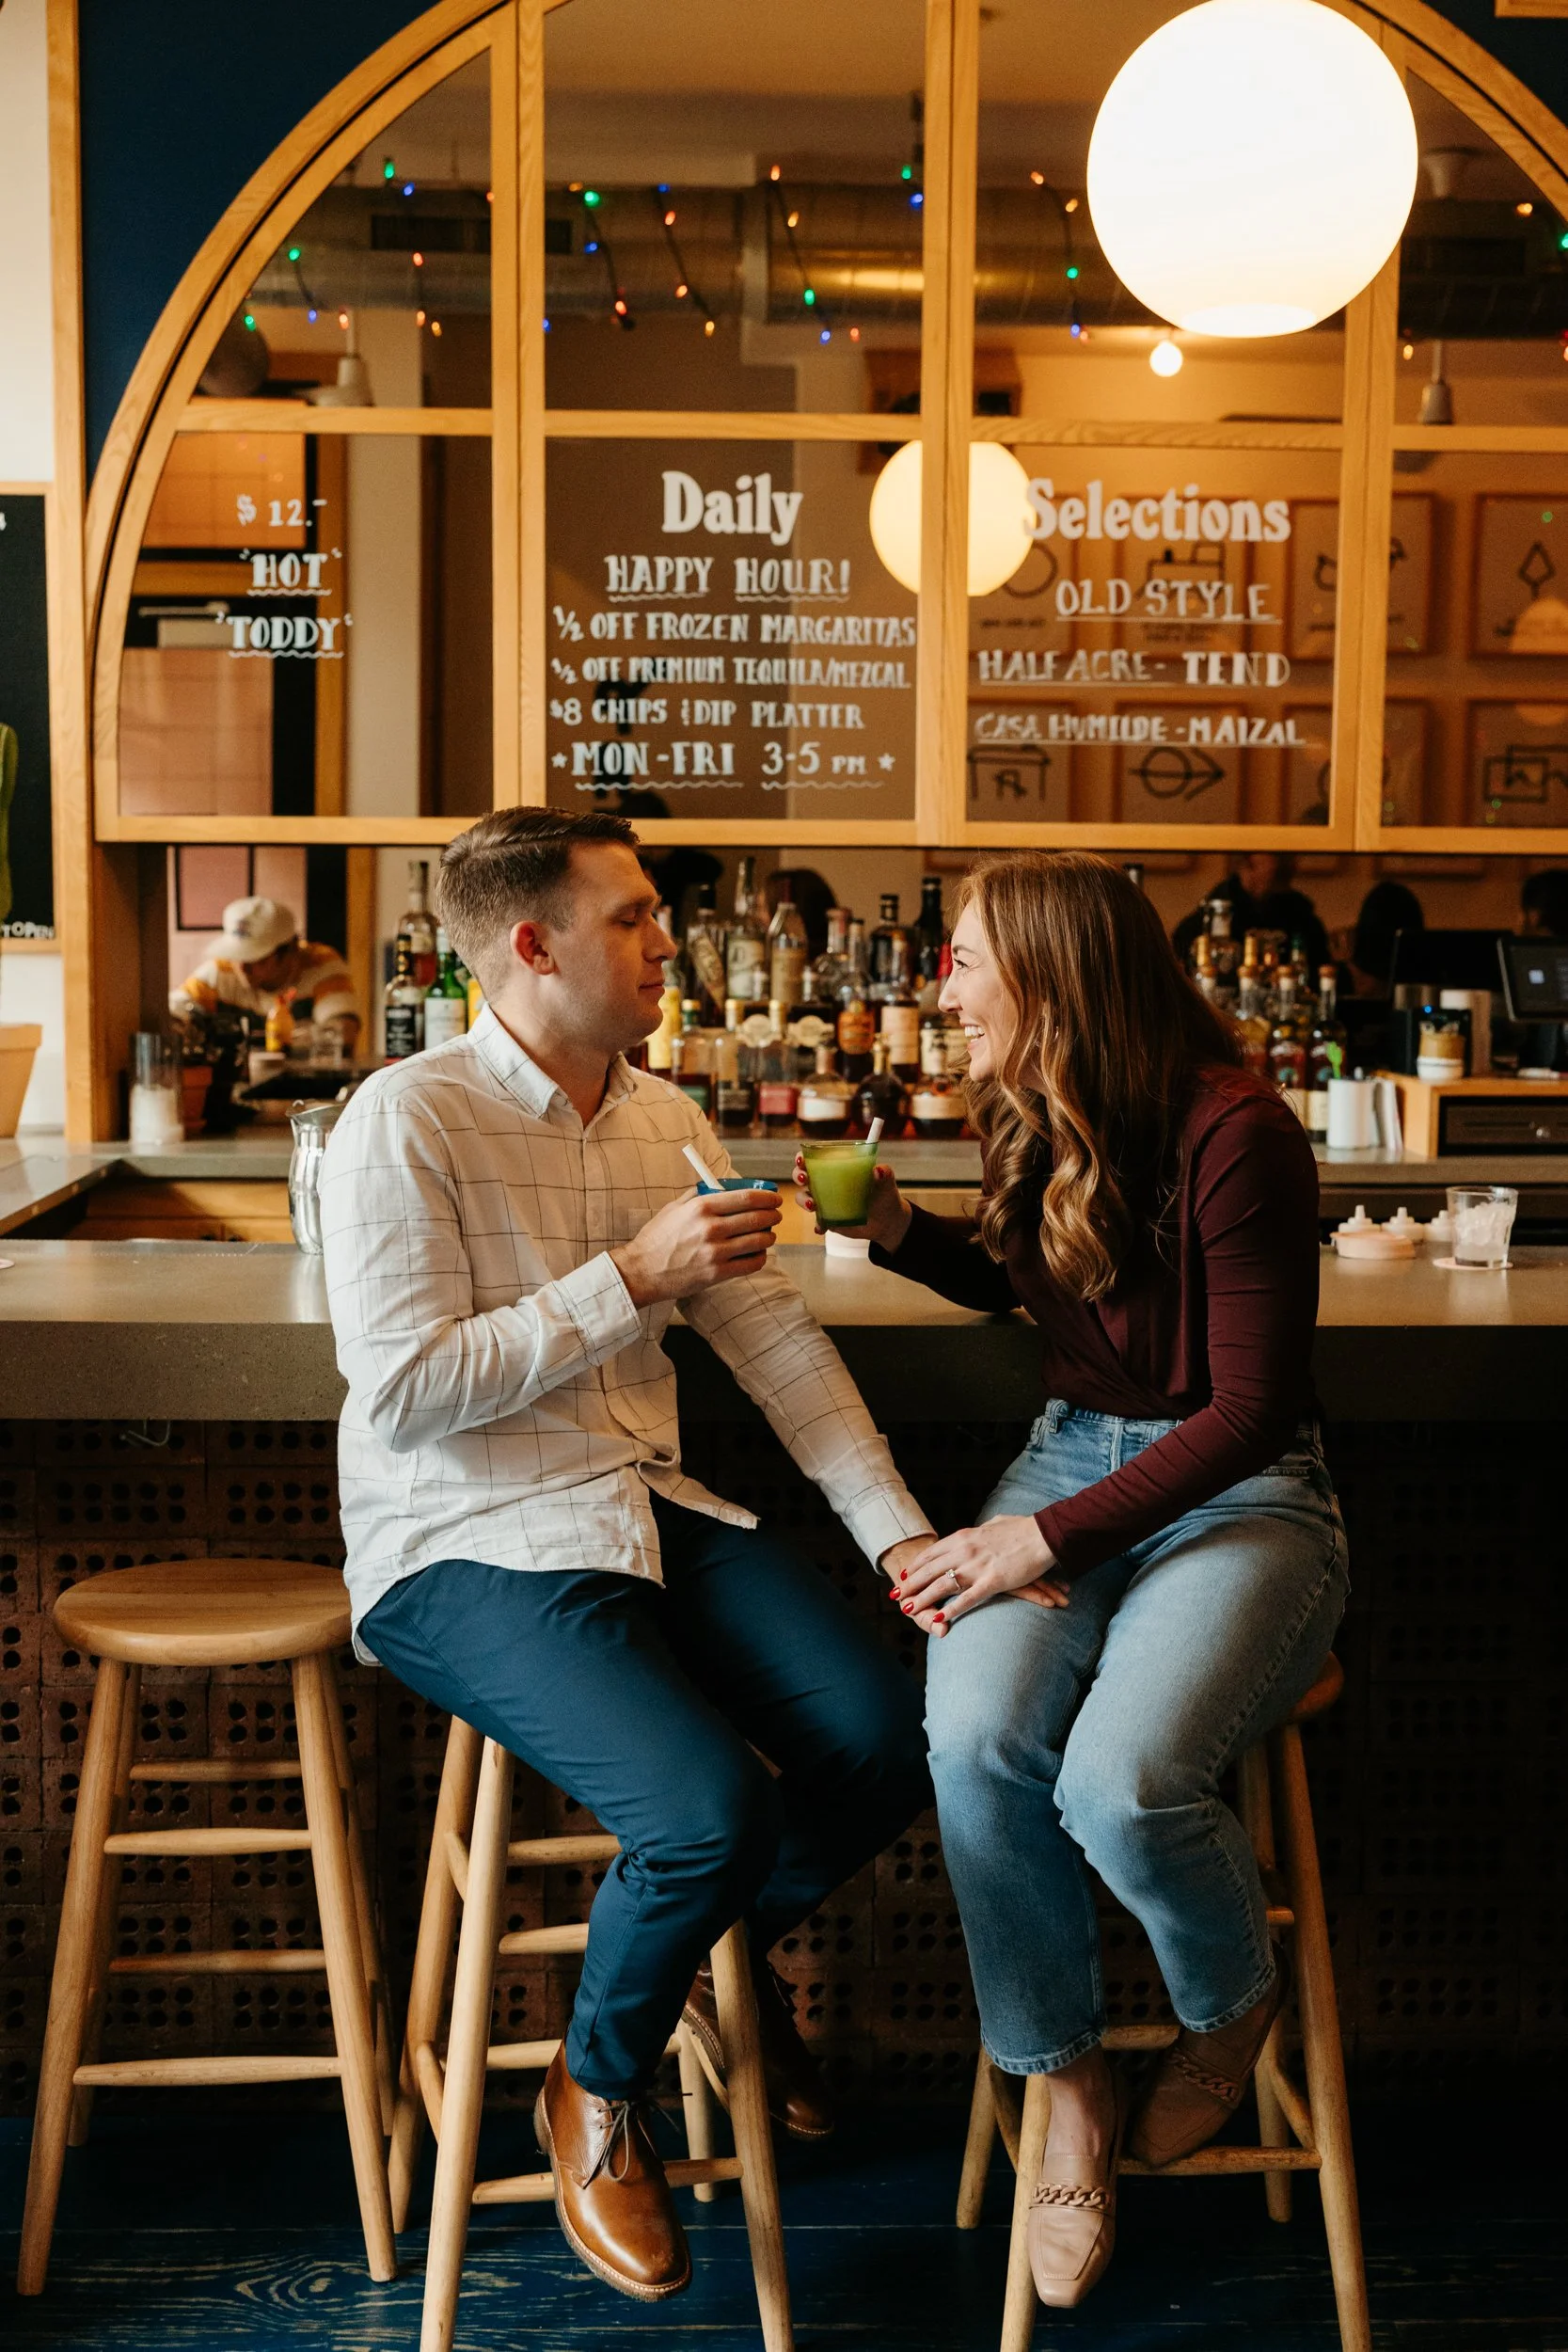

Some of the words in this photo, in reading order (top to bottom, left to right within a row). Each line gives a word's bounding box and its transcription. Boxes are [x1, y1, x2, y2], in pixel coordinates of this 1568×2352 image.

[661, 470, 802, 546] Daily
[1023, 478, 1291, 542] Selections
[605, 556, 714, 594] HAPPY
[734, 558, 850, 595] HOUR!
[1055, 579, 1132, 616] OLD
[1145, 580, 1275, 622] STYLE
[590, 612, 639, 641] OFF
[645, 612, 749, 643] FROZEN
[760, 614, 916, 647] MARGARITAS
[582, 657, 623, 683] OFF
[628, 657, 725, 684] PREMIUM
[977, 650, 1059, 681] HALF
[1182, 651, 1291, 687] TEND
[591, 698, 667, 724] CHIPS
[751, 700, 864, 729] PLATTER
[761, 741, 821, 775] 3-5
